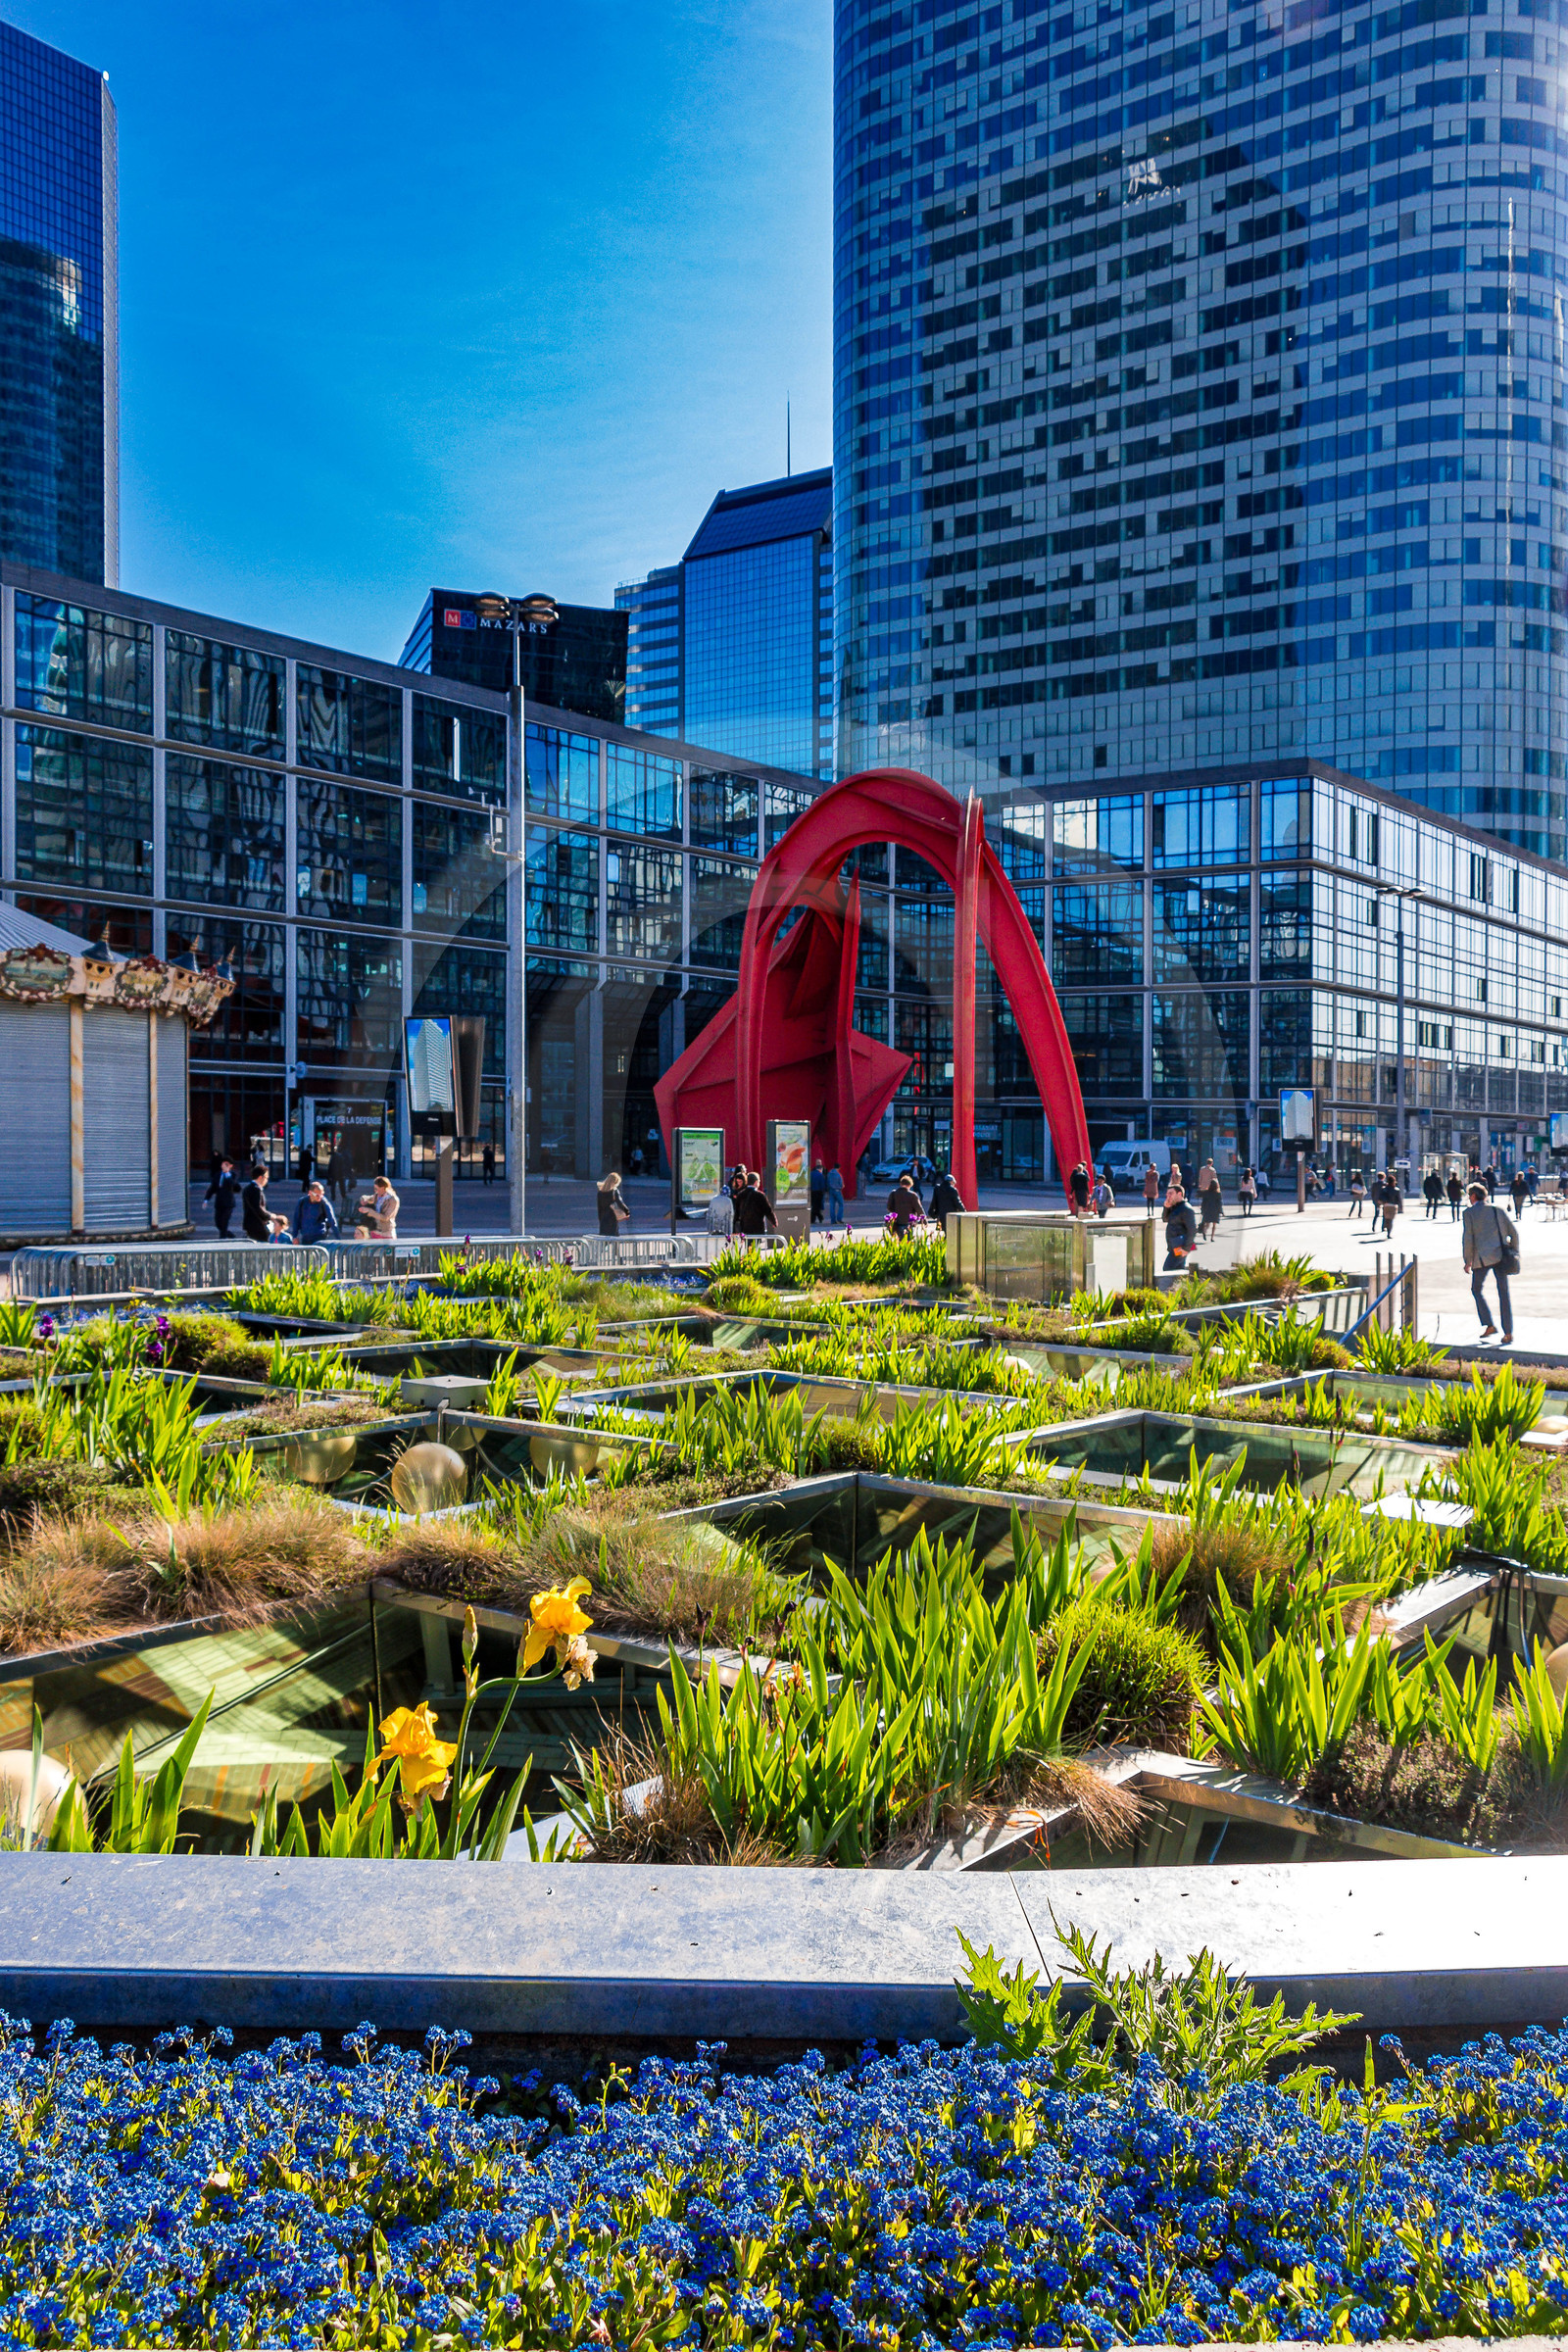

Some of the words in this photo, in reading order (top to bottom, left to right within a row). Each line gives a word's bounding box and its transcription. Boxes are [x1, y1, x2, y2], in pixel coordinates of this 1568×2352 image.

[447, 613, 458, 623] M
[480, 618, 547, 634] MAZARS
[317, 1115, 336, 1124] PLACE
[337, 1115, 346, 1124] DE
[356, 1116, 382, 1125] DEFENSE
